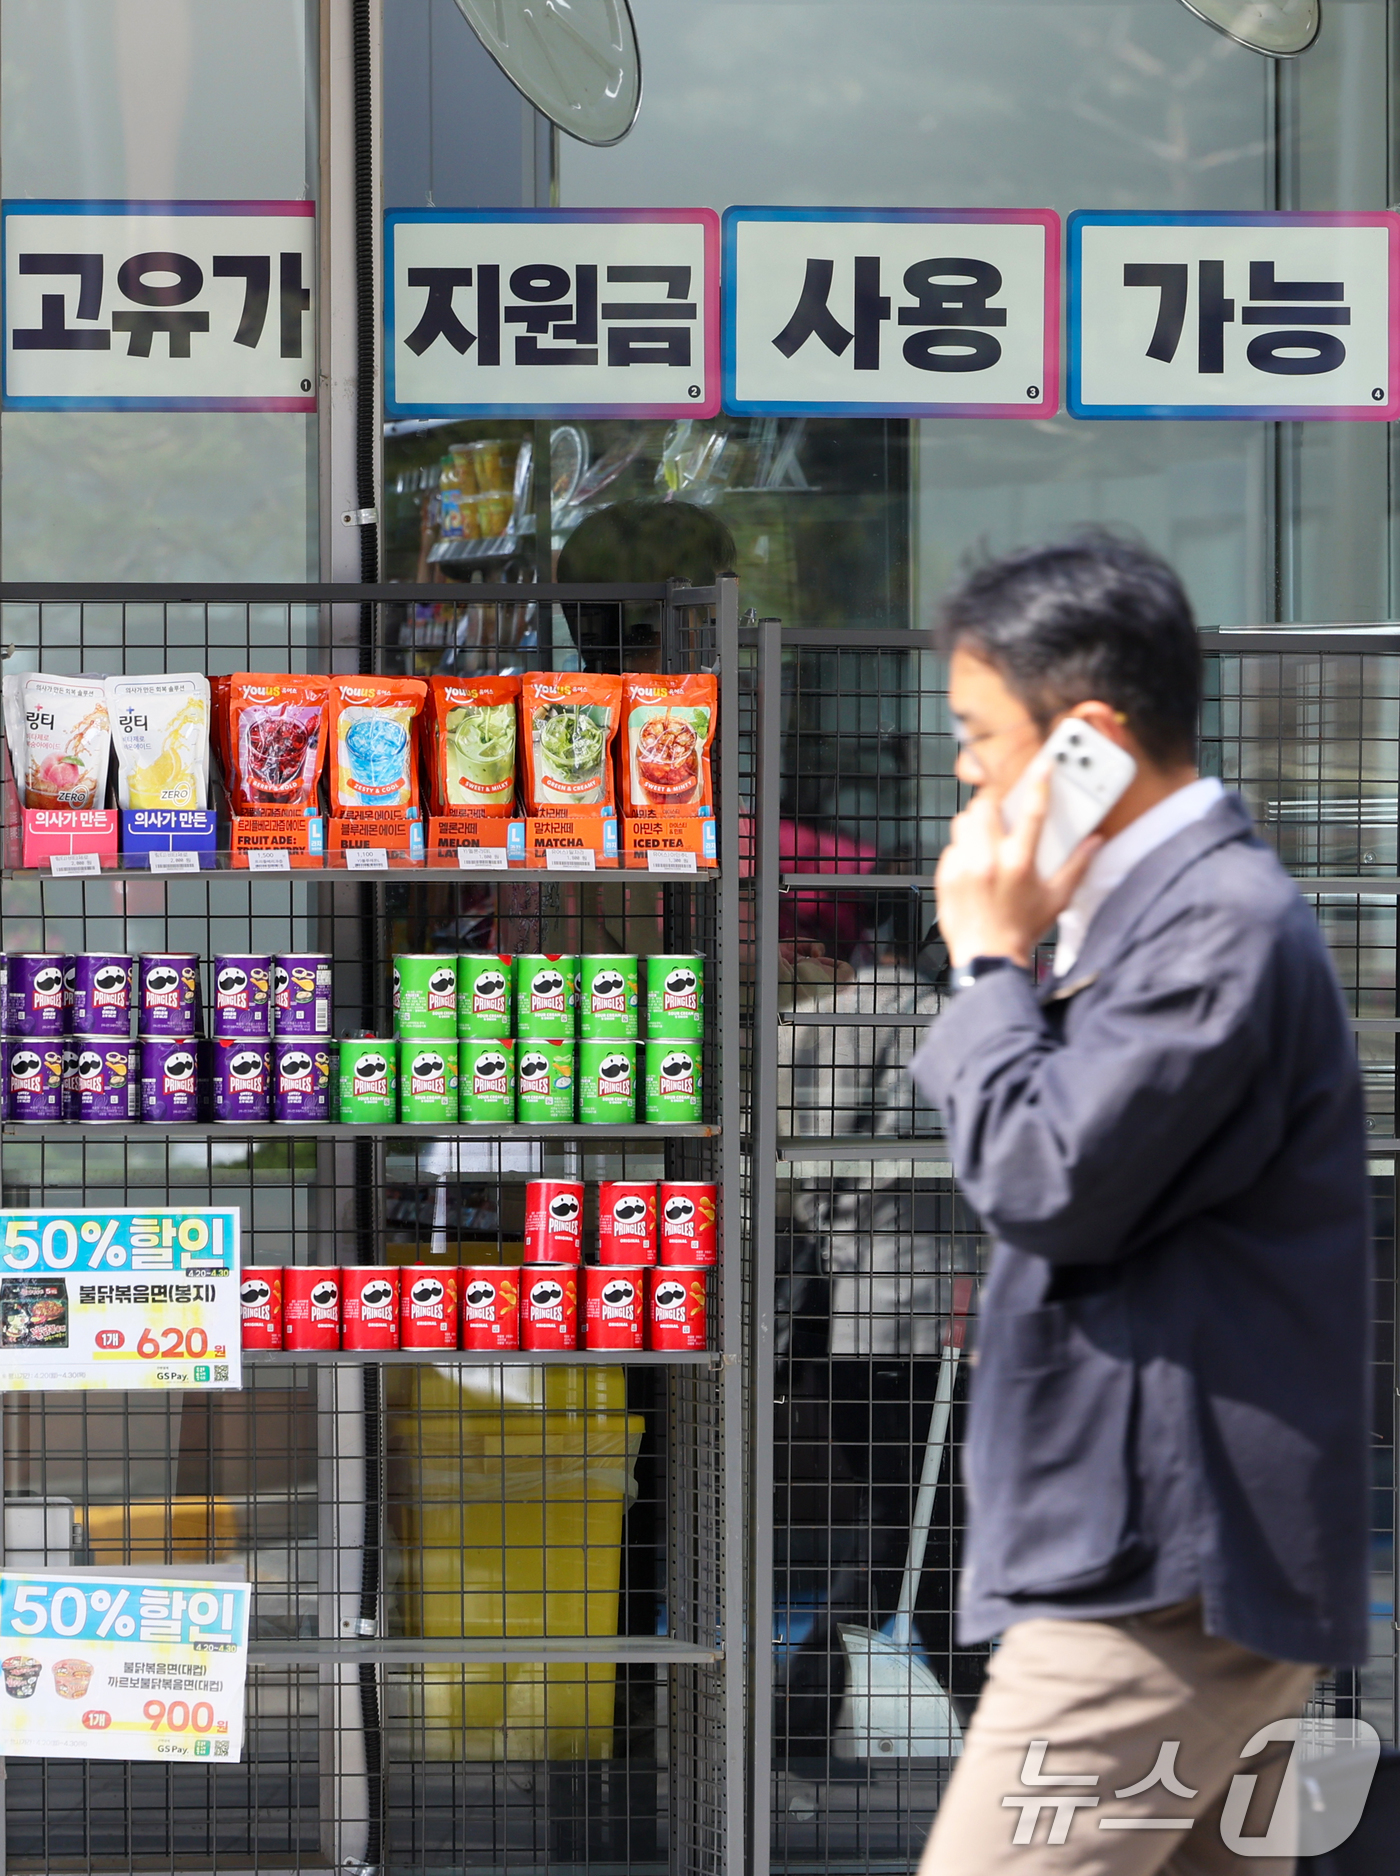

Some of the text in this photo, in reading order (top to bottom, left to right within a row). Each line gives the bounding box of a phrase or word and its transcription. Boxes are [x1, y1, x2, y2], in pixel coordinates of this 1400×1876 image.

[12, 251, 1352, 376] 고유가 지원금 사용 가능
[243, 685, 280, 699] youus
[339, 686, 375, 700] youus
[444, 686, 478, 700] youus
[534, 684, 572, 698] youus
[630, 686, 668, 700] youus
[26, 711, 54, 730] 링티
[119, 715, 148, 733] 링티
[252, 781, 274, 790] BERRY
[354, 783, 373, 793] ZESTY
[382, 784, 399, 792] COOL
[465, 781, 484, 791] SWEET
[491, 781, 509, 791] MILKY
[547, 780, 566, 791] GREEN
[573, 780, 596, 791] CREAMY
[644, 782, 665, 792] SWEET
[673, 780, 692, 791] MINTY
[58, 792, 86, 801] ZERO
[161, 790, 188, 799] ZERO
[35, 811, 107, 827] 의사가 만든
[134, 812, 207, 828] 의사가 만든
[312, 824, 321, 837] L
[341, 823, 406, 836] 블루레몬에이드
[414, 828, 421, 842] L
[439, 822, 477, 834] 멜론라떼
[512, 828, 520, 842] L
[534, 822, 573, 834] 말차라떼
[607, 826, 616, 839] L
[633, 822, 663, 835] 아민추
[706, 826, 715, 840] L
[238, 836, 296, 845] FRUIT ADE:
[341, 840, 370, 848] BLUE
[438, 838, 480, 847] MELON
[534, 838, 584, 847] MATCHA
[634, 839, 684, 848] ICED TEA
[94, 990, 125, 1008] PRINGLES
[146, 991, 178, 1009] PRINGLES
[217, 992, 248, 1010] PRINGLES
[474, 995, 505, 1012] PRINGLES
[532, 994, 564, 1012] PRINGLES
[592, 994, 624, 1012] PRINGLES
[664, 993, 697, 1011] PRINGLES
[11, 1077, 40, 1092] PRINGLES
[165, 1077, 194, 1093] PRINGLES
[230, 1077, 262, 1093] PRINGLES
[281, 1077, 312, 1093] PRINGLES
[354, 1078, 387, 1096] PRINGLES
[412, 1076, 445, 1095] PRINGLES
[474, 1076, 507, 1094] PRINGLES
[520, 1077, 549, 1094] PRINGLES
[599, 1078, 630, 1095] PRINGLES
[661, 1077, 693, 1094] PRINGLES
[549, 1218, 578, 1235] PRINGLES
[614, 1221, 646, 1237] PRINGLES
[664, 1221, 694, 1237] PRINGLES
[79, 1285, 215, 1304] 불닭볶음면(봉지)
[362, 1306, 393, 1321] PRINGLES
[411, 1304, 443, 1319] PRINGLES
[466, 1306, 495, 1321] PRINGLES
[530, 1306, 562, 1321] PRINGLES
[602, 1305, 634, 1320] PRINGLES
[655, 1306, 686, 1322] PRINGLES
[101, 1327, 226, 1359] 1개 620 원
[123, 1661, 206, 1676] 불닭볶음면(대컵)
[108, 1677, 223, 1692] 까르보불닭볶음면(대컵)
[88, 1700, 228, 1733] 1개 900 원
